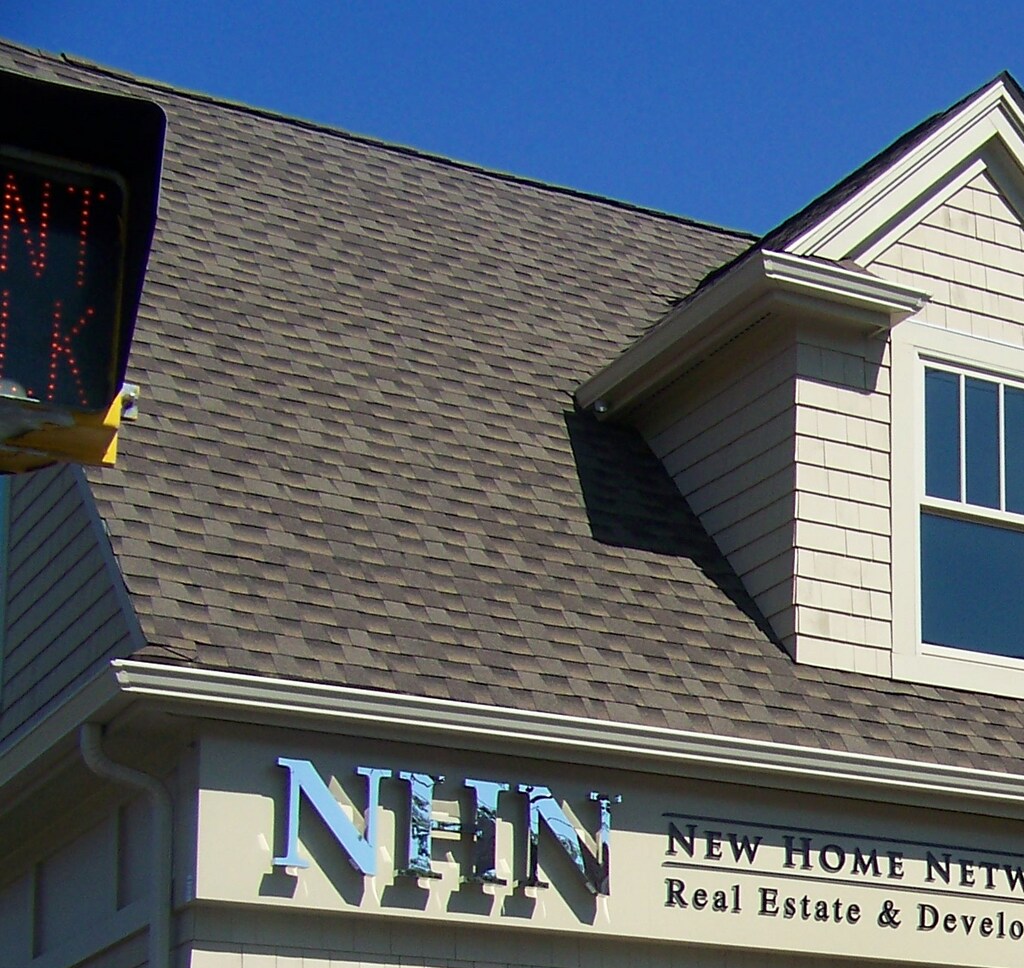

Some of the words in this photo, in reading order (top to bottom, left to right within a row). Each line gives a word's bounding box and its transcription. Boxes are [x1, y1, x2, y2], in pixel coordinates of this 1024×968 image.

[272, 757, 622, 896] NHN
[664, 821, 763, 865] NEW
[782, 836, 904, 878] HOME
[664, 878, 742, 913] Real
[758, 888, 861, 925] Estate
[877, 900, 901, 928] &
